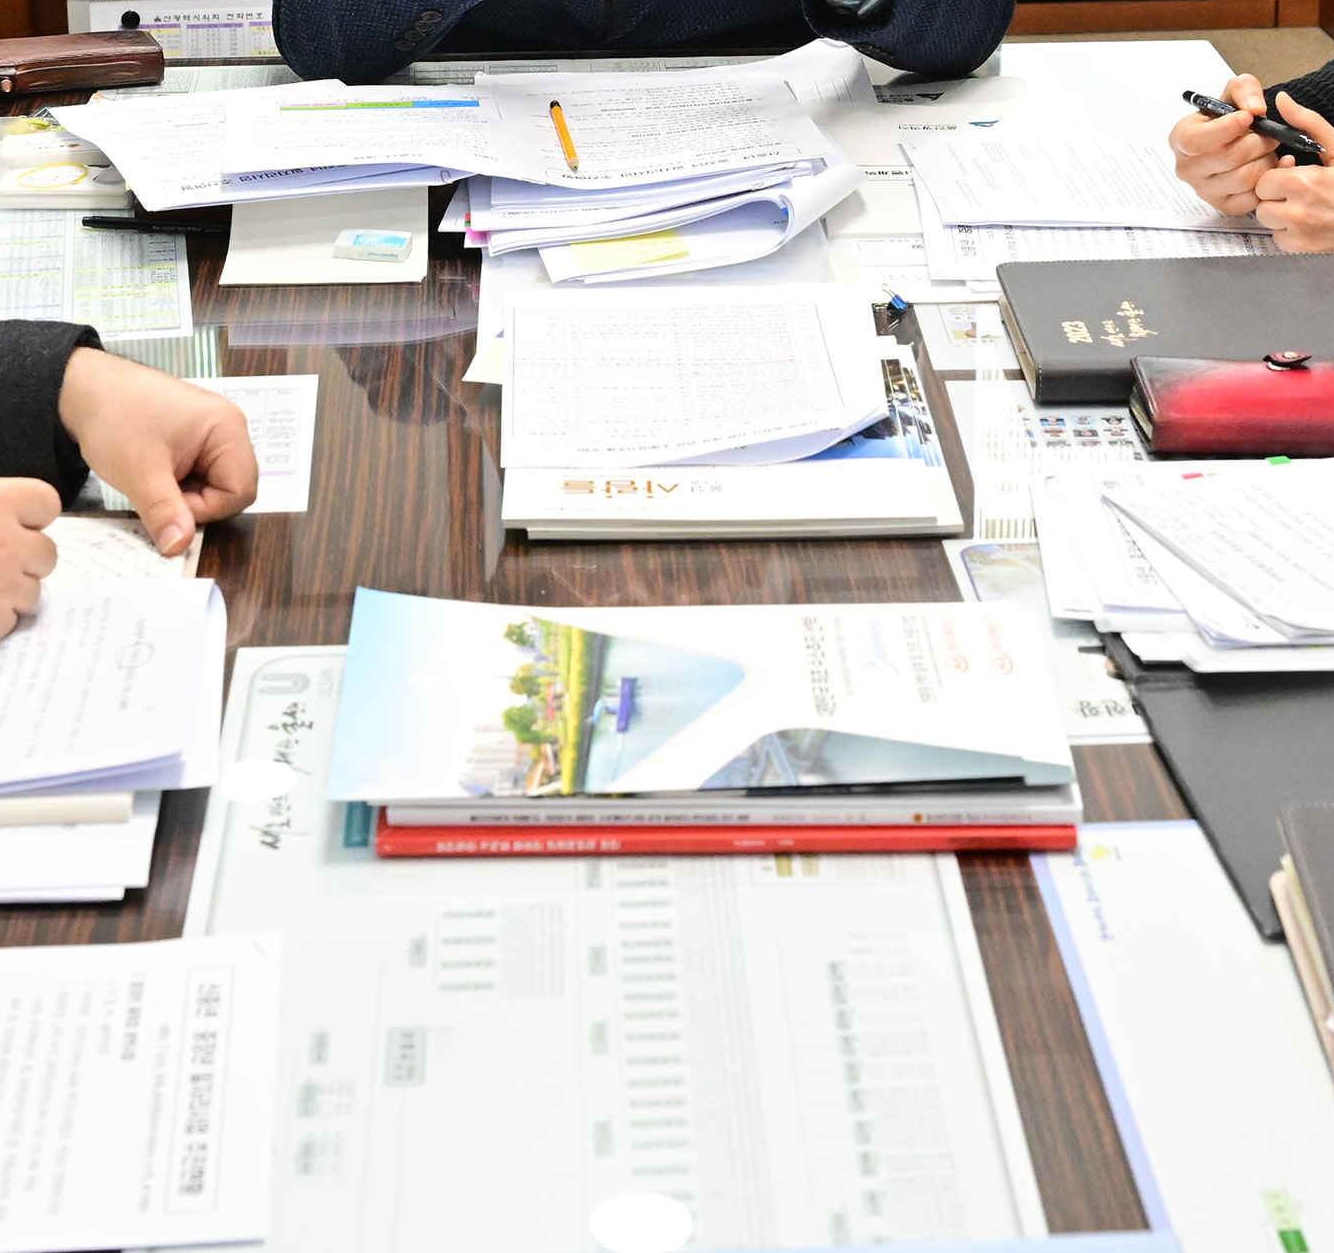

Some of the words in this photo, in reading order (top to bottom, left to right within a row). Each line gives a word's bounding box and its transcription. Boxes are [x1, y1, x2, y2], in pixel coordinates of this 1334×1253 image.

[154, 13, 220, 22] 울산광역시의회
[226, 12, 264, 21] 전화번호
[1061, 320, 1094, 344] 2023
